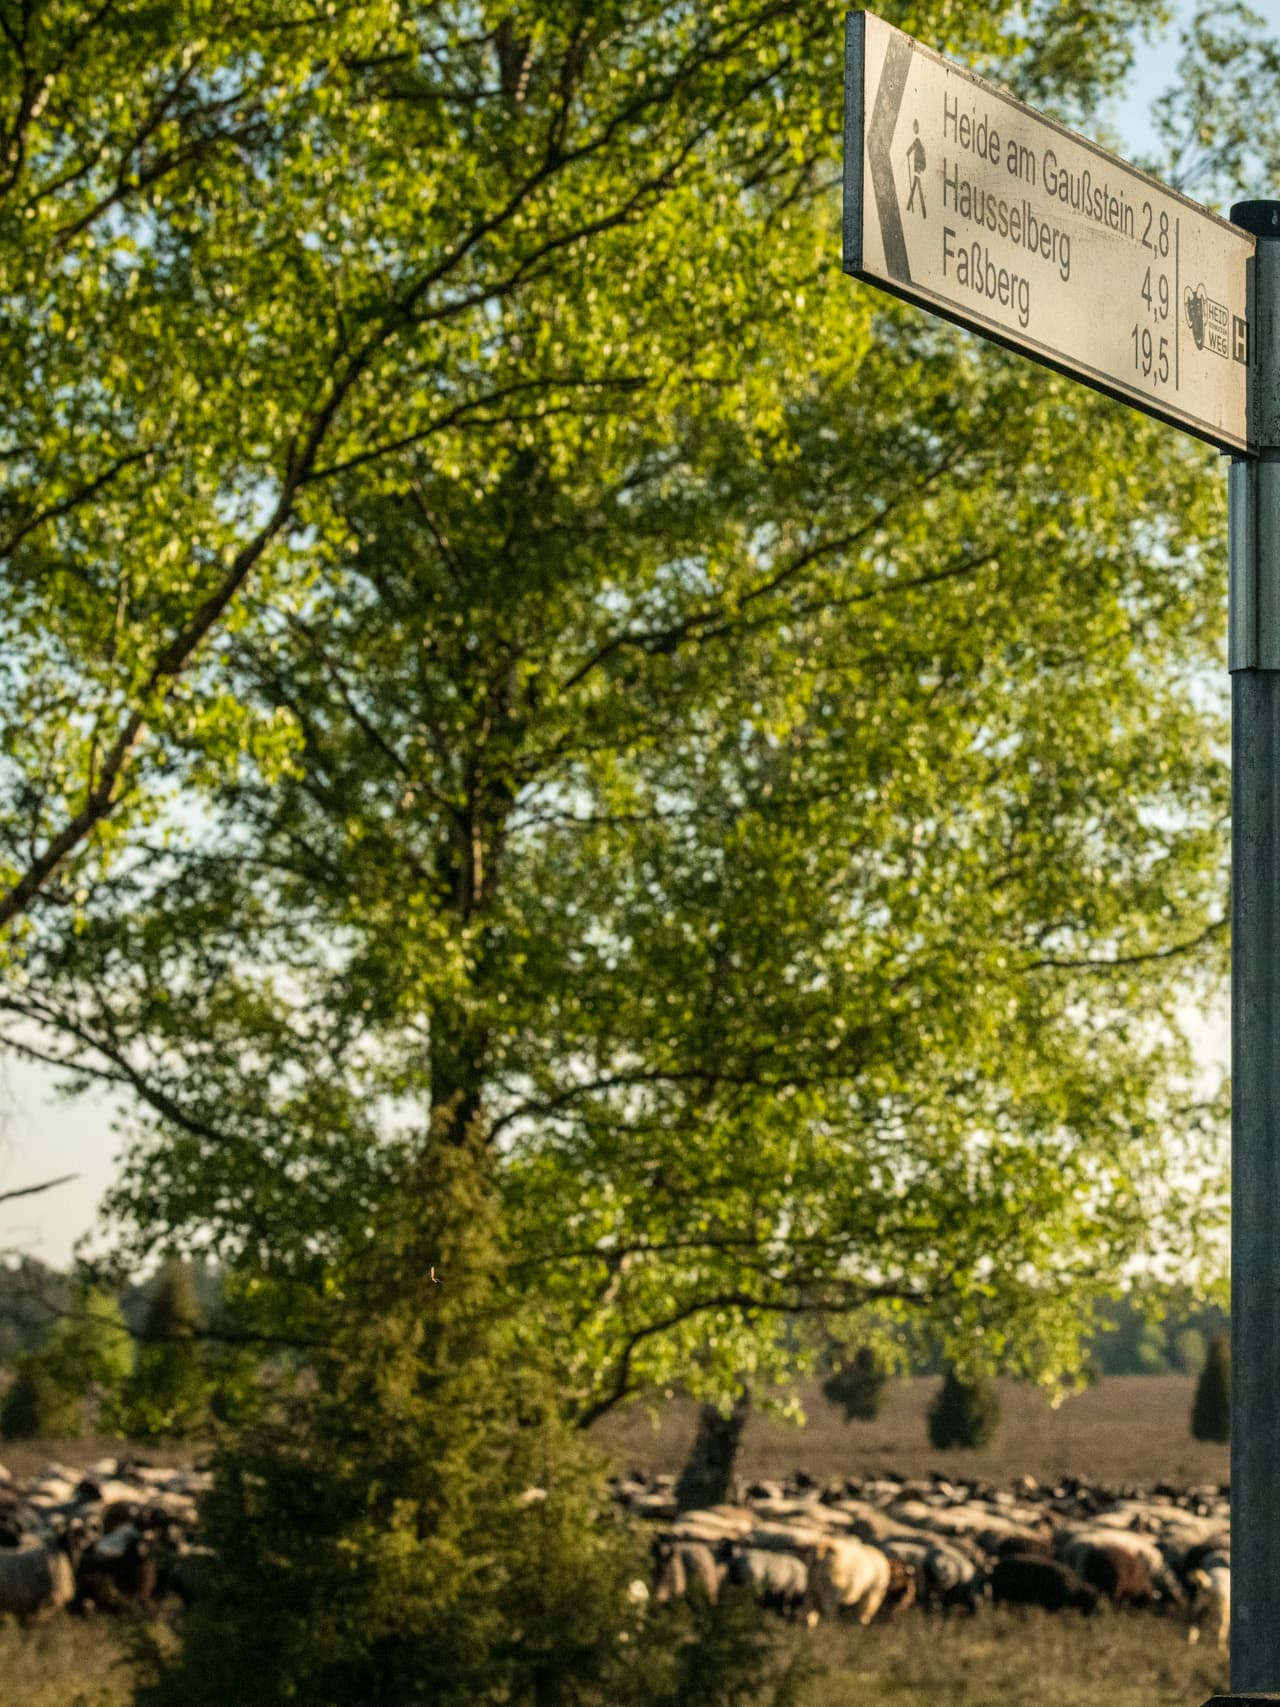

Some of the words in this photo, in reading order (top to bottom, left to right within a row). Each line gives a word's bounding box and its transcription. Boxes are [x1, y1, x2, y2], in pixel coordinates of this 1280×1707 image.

[943, 91, 1001, 164] Heide
[1006, 138, 1037, 187] am
[1042, 148, 1135, 240] Gaußstein
[1141, 201, 1170, 260] 2,8
[942, 157, 1072, 283] Hausselberg
[1140, 266, 1170, 322] 4,9
[942, 226, 1031, 328] Faßberg
[1131, 323, 1169, 388] 19,5
[1208, 303, 1228, 327] HEID
[1208, 331, 1228, 355] WEG
[1235, 318, 1248, 364] H
